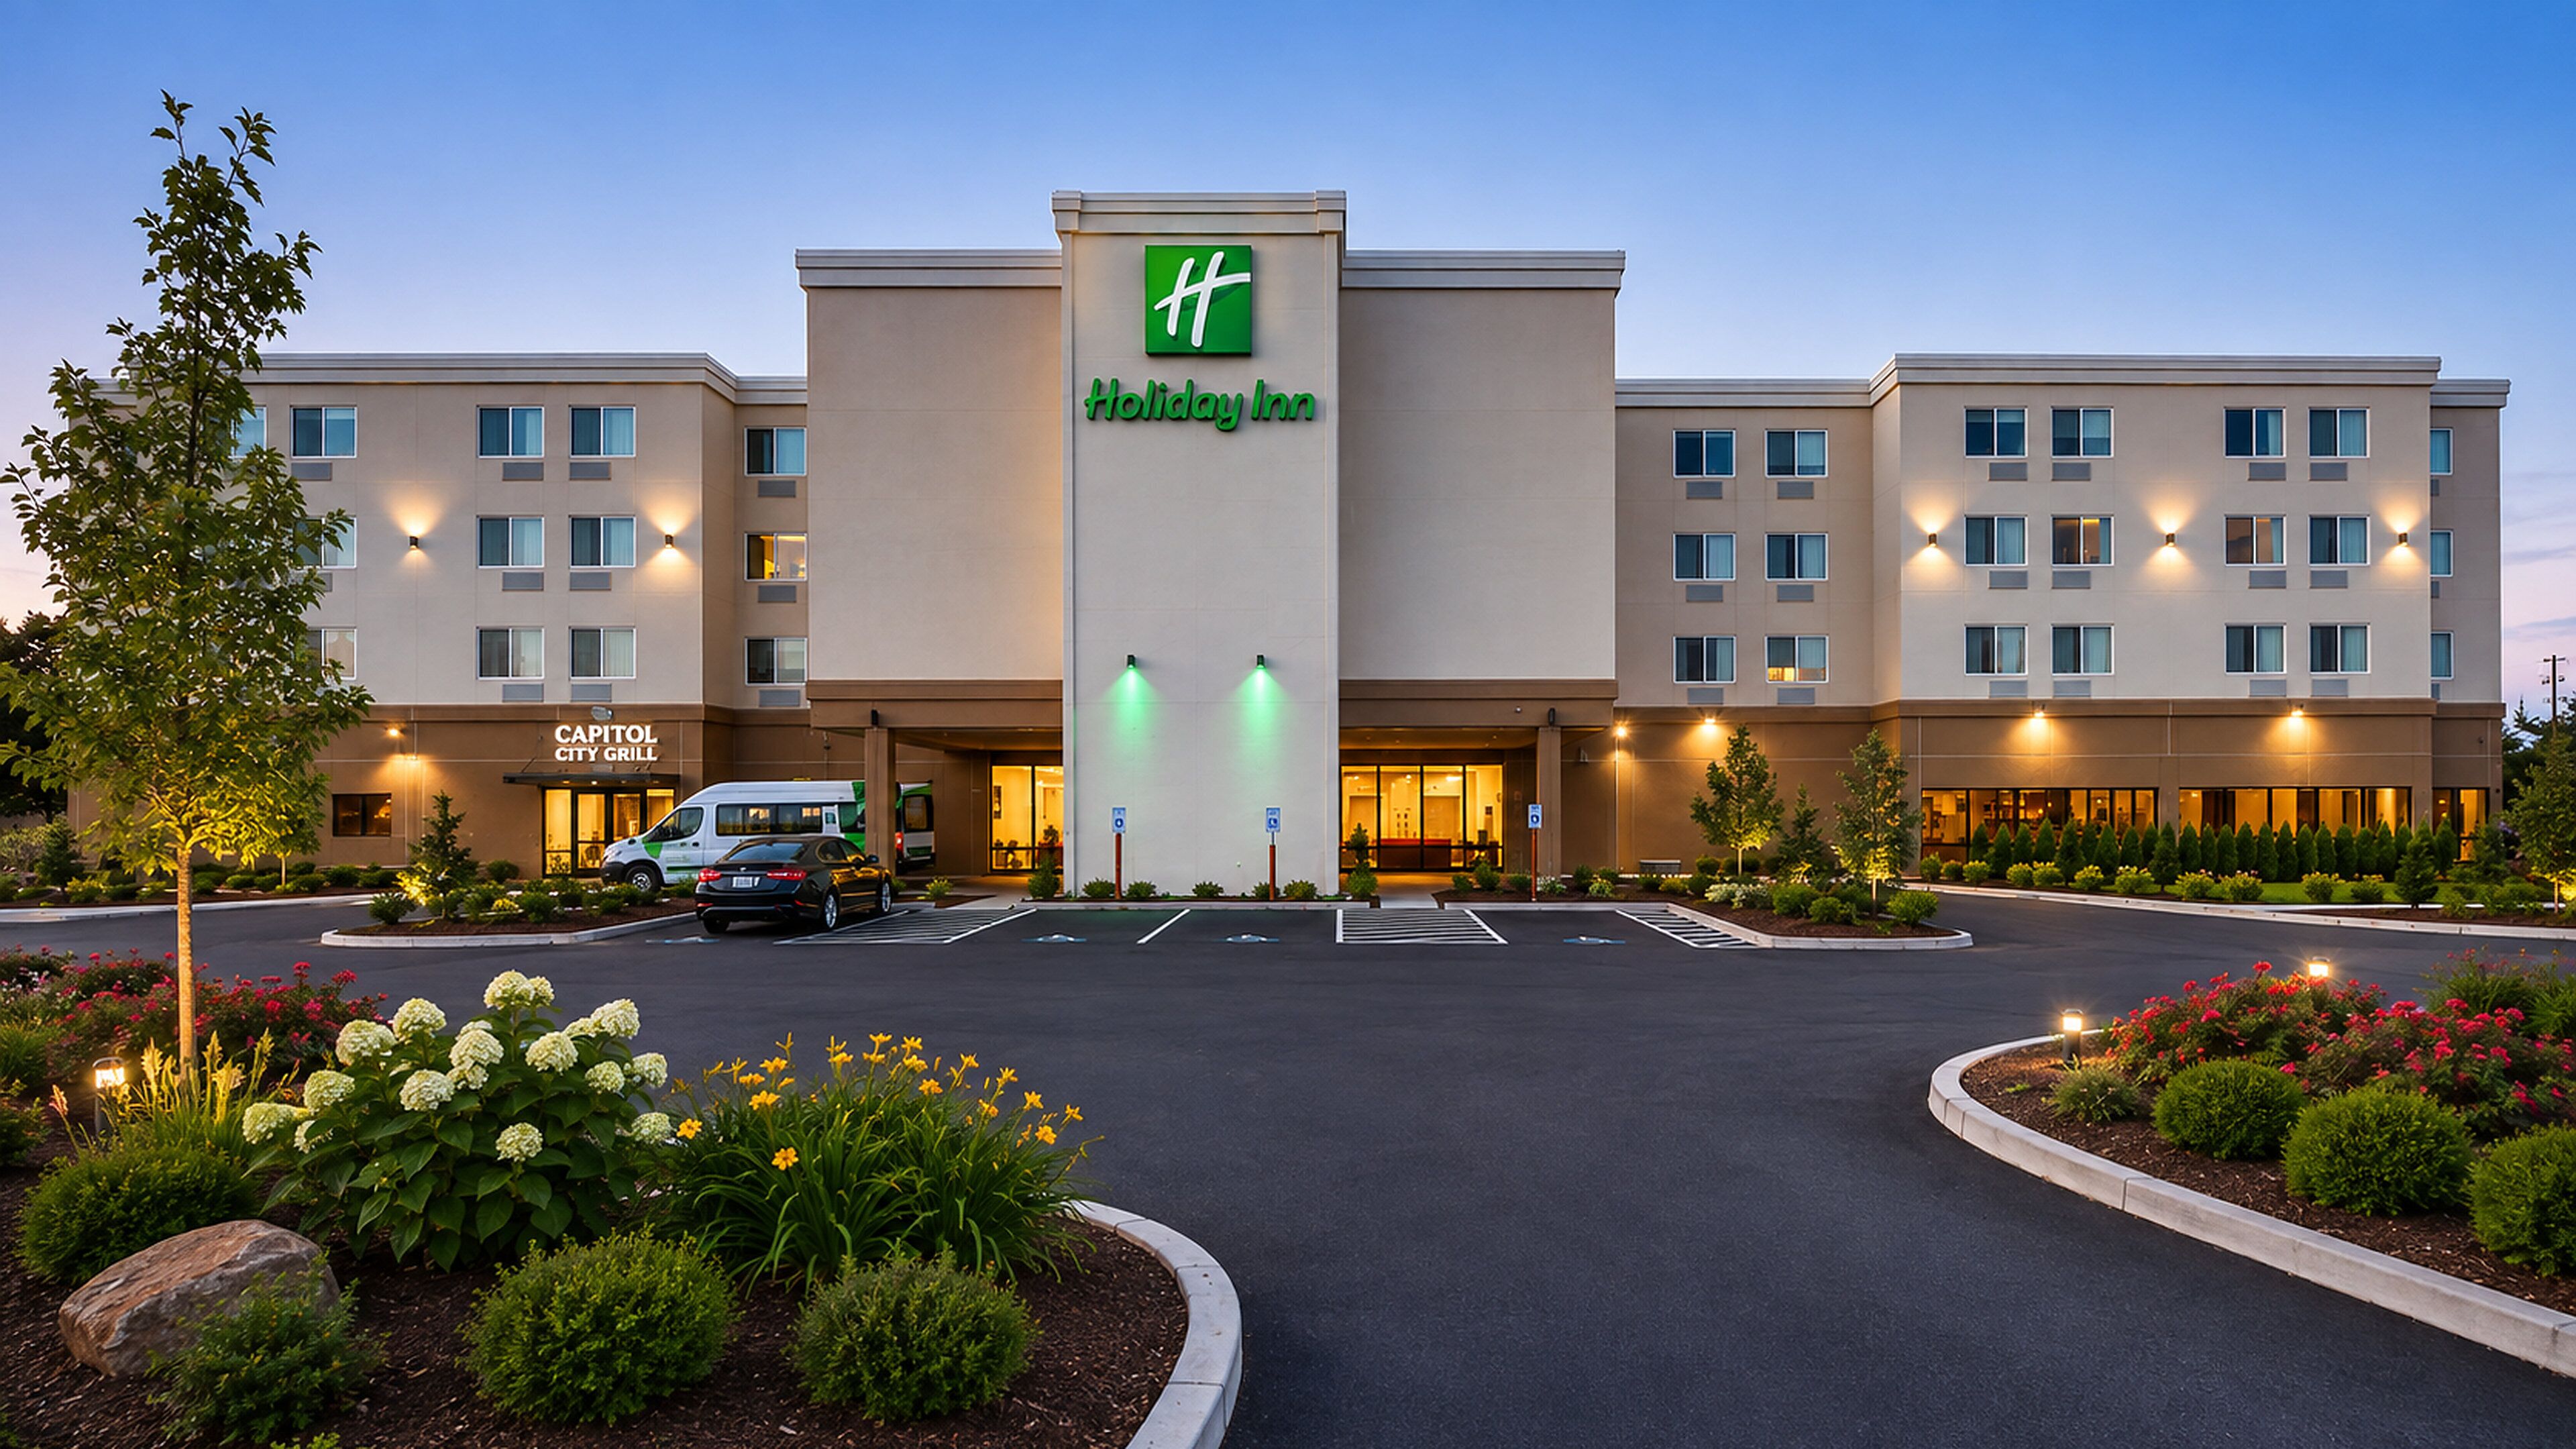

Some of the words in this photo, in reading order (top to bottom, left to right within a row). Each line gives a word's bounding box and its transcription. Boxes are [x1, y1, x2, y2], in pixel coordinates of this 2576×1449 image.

[1084, 377, 1243, 431] Holiday
[1251, 378, 1316, 421] Inn
[555, 724, 658, 743] CAPITOL
[555, 747, 598, 761] CITY
[604, 747, 658, 761] GRILL
